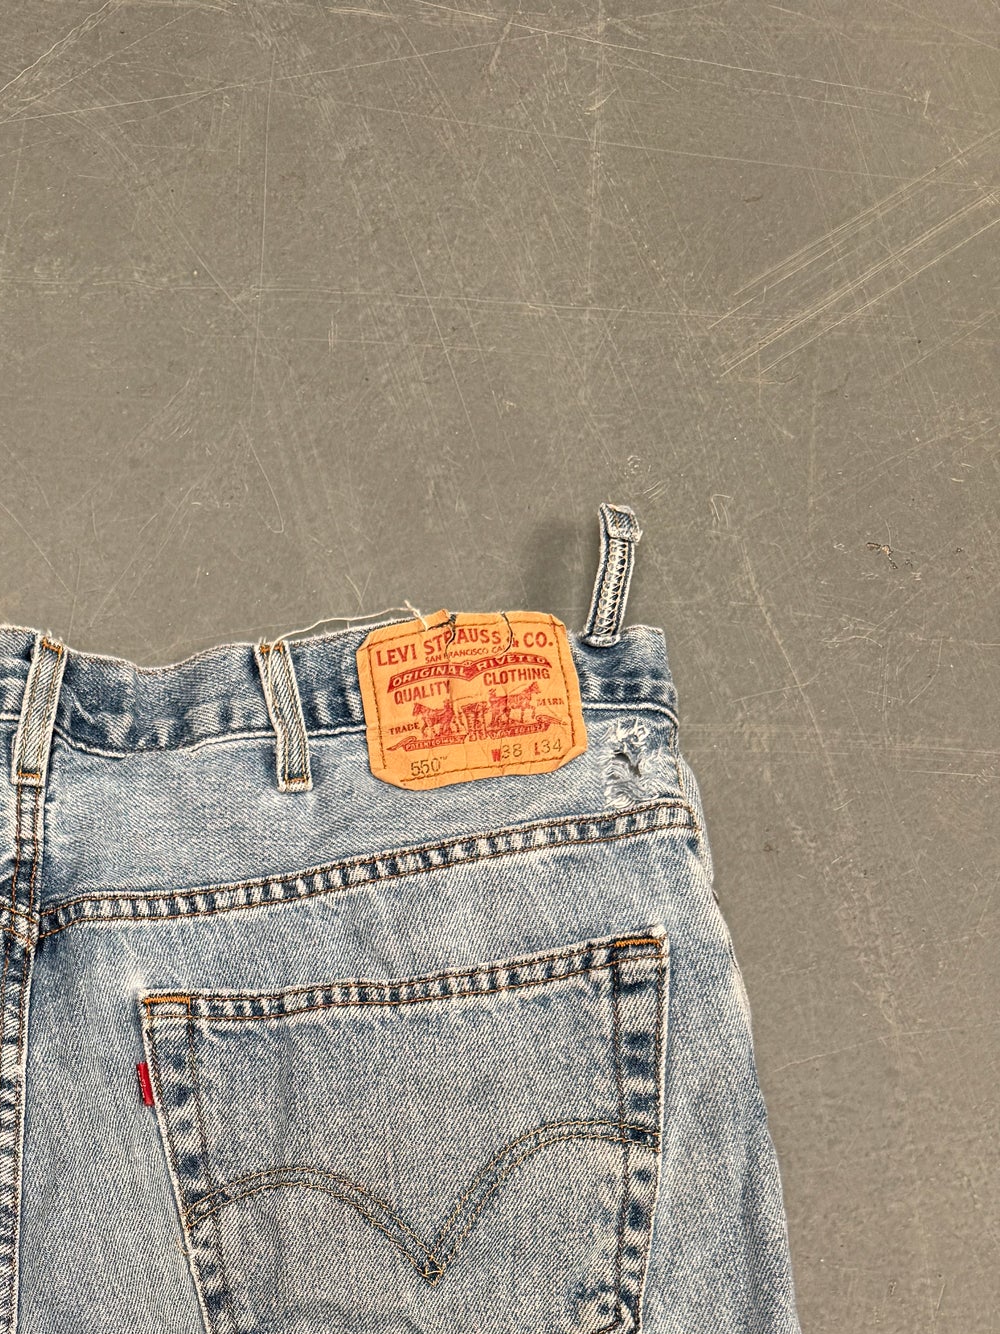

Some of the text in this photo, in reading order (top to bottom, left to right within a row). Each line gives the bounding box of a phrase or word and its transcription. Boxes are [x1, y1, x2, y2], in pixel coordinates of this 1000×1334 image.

[376, 643, 417, 666] LEVI
[523, 631, 553, 648] CO.
[425, 654, 442, 664] SAN
[392, 654, 546, 687] ORIGINAL RIVETED
[394, 667, 551, 705] QUALITY CLOTHING
[389, 722, 420, 735] TRADE
